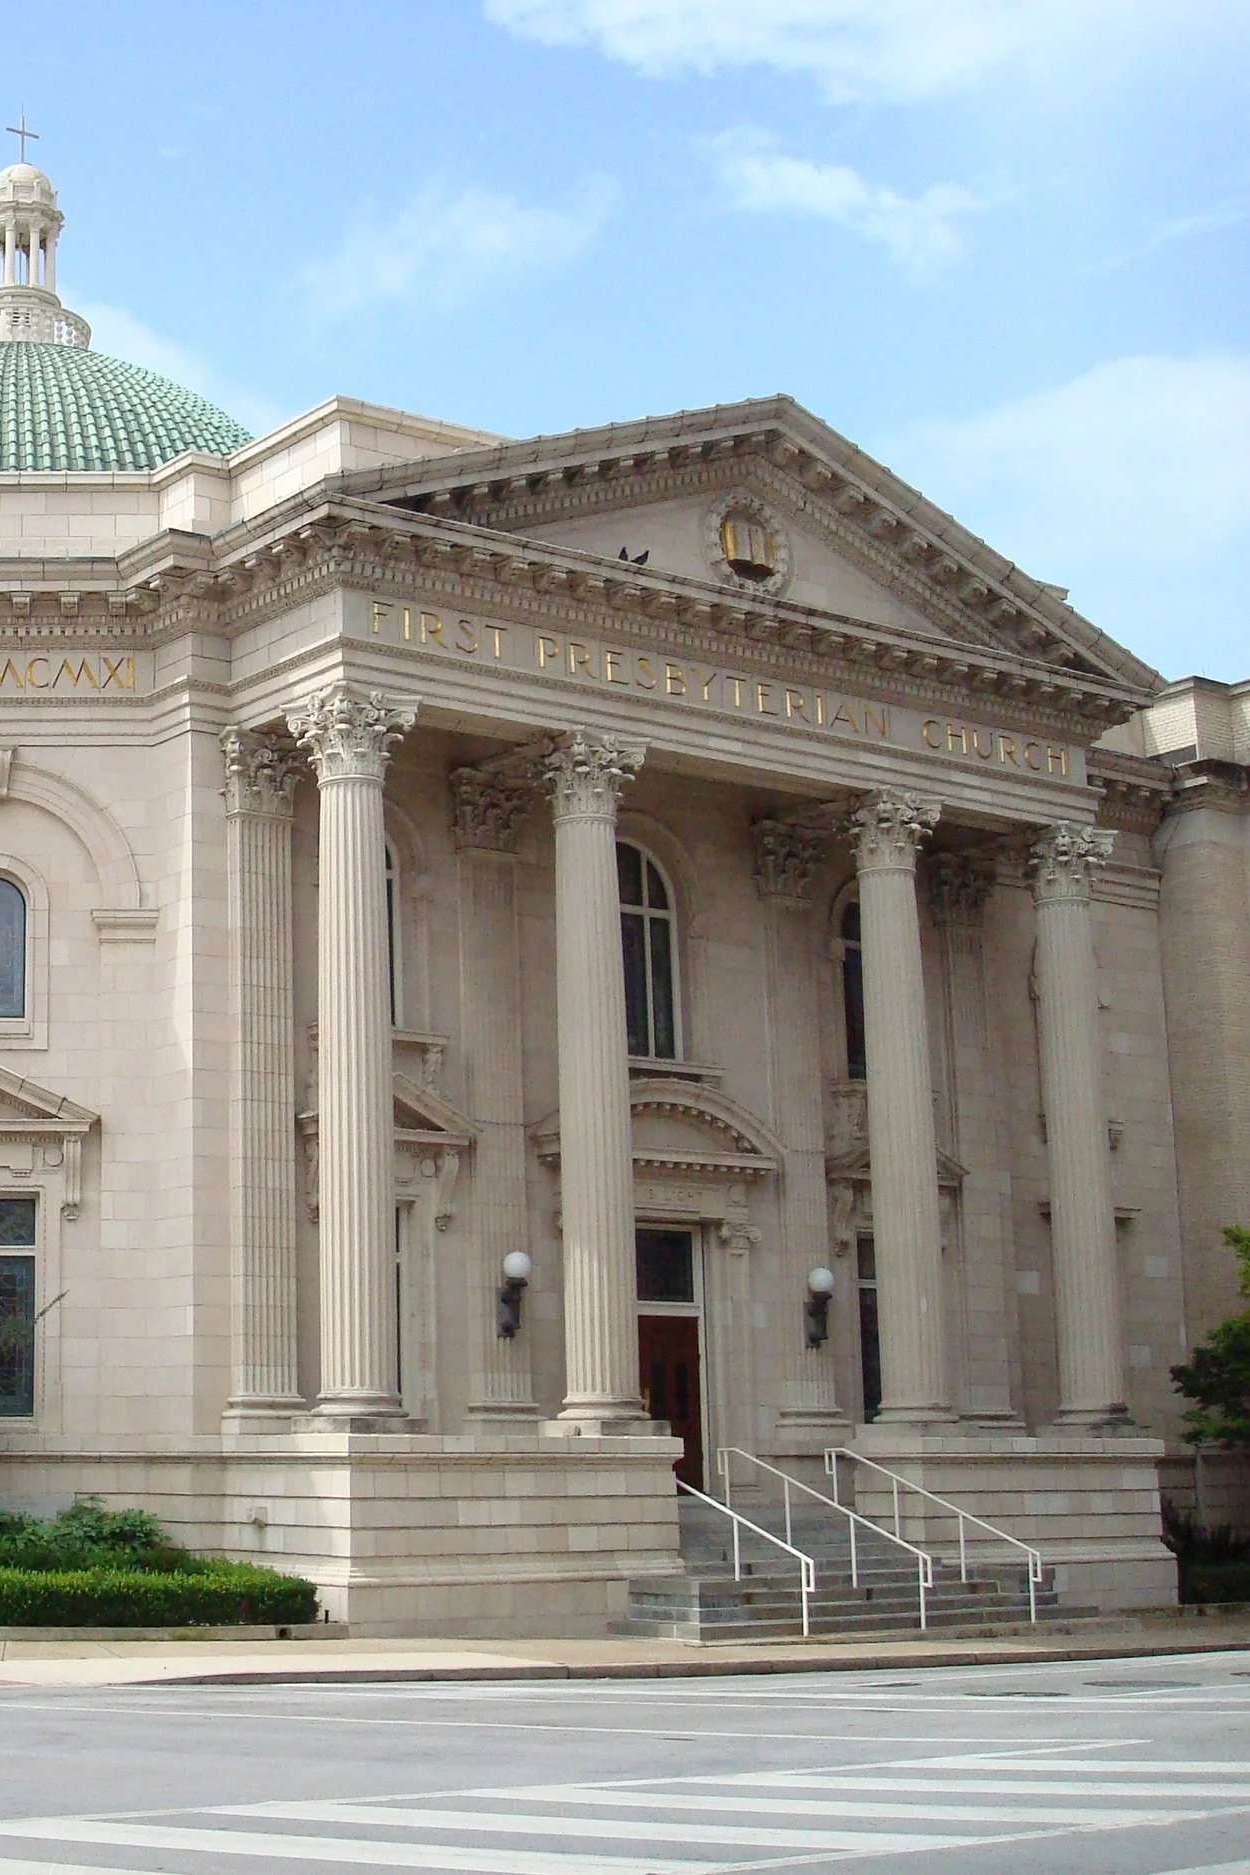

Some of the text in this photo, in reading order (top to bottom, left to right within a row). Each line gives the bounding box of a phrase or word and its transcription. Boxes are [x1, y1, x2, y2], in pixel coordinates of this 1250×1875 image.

[372, 601, 1070, 777] FIRST PRESBYTERIAN CHURCH
